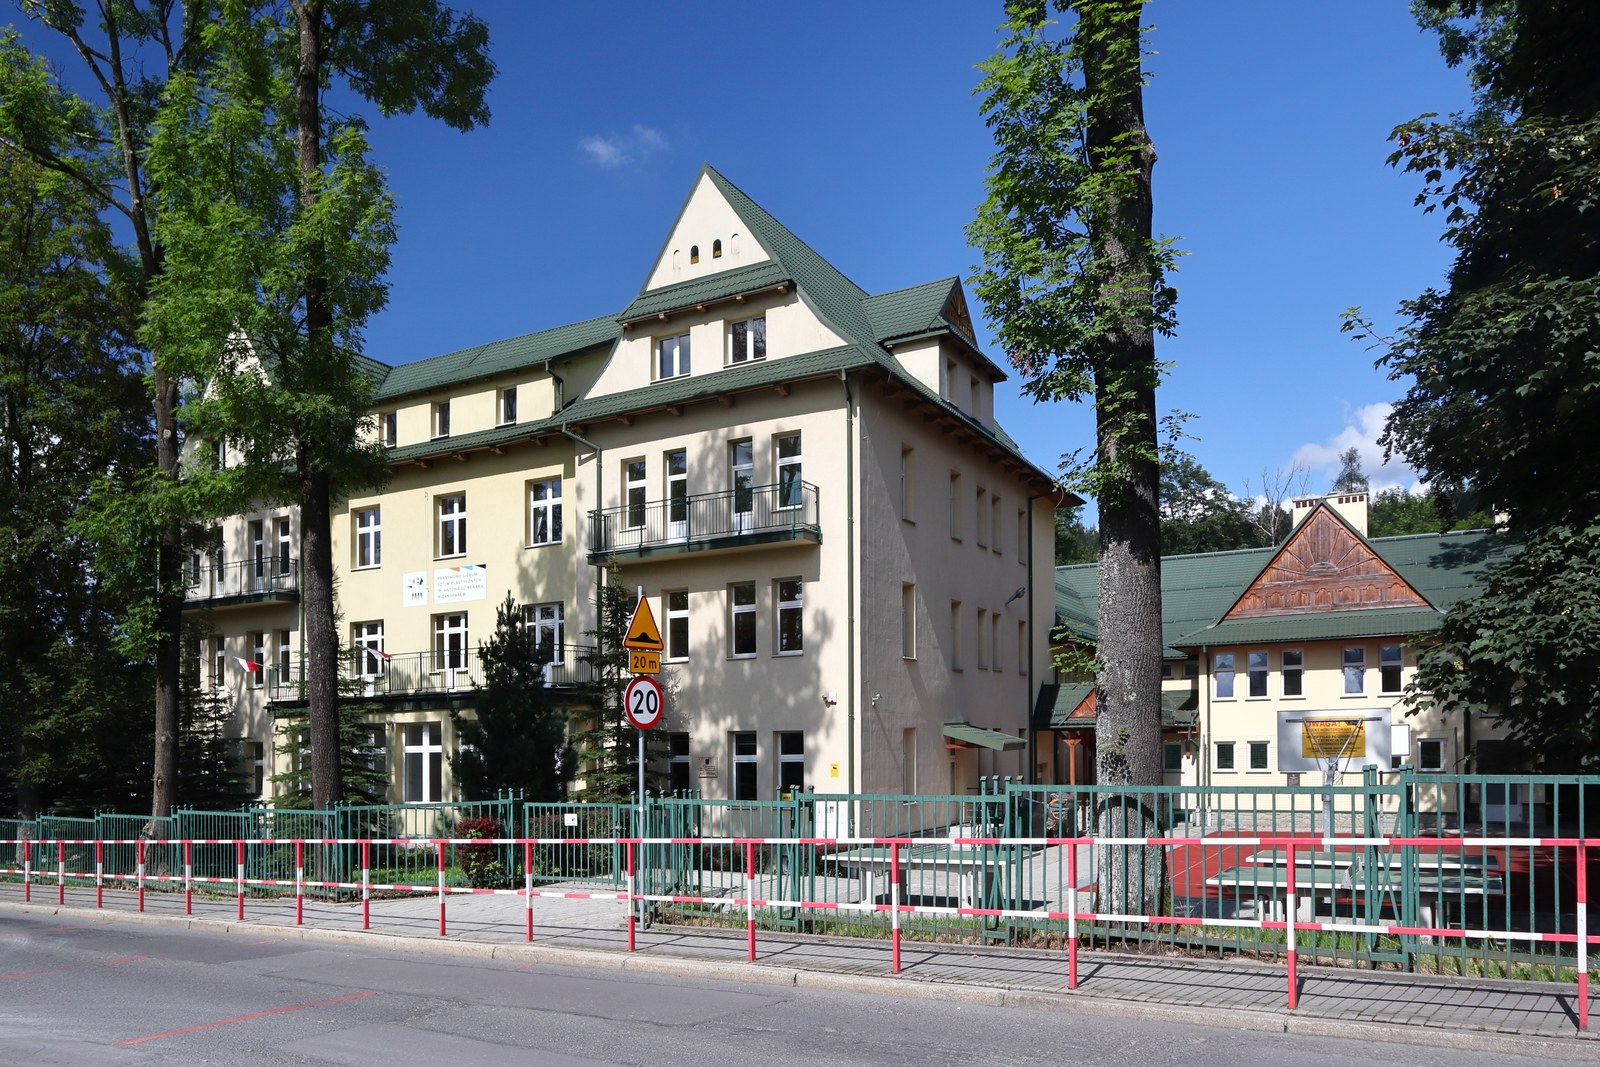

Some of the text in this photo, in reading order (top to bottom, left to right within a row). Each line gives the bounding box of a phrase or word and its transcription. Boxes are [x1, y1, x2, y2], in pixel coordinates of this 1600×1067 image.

[633, 655, 657, 669] 20 m
[633, 689, 658, 714] 20
